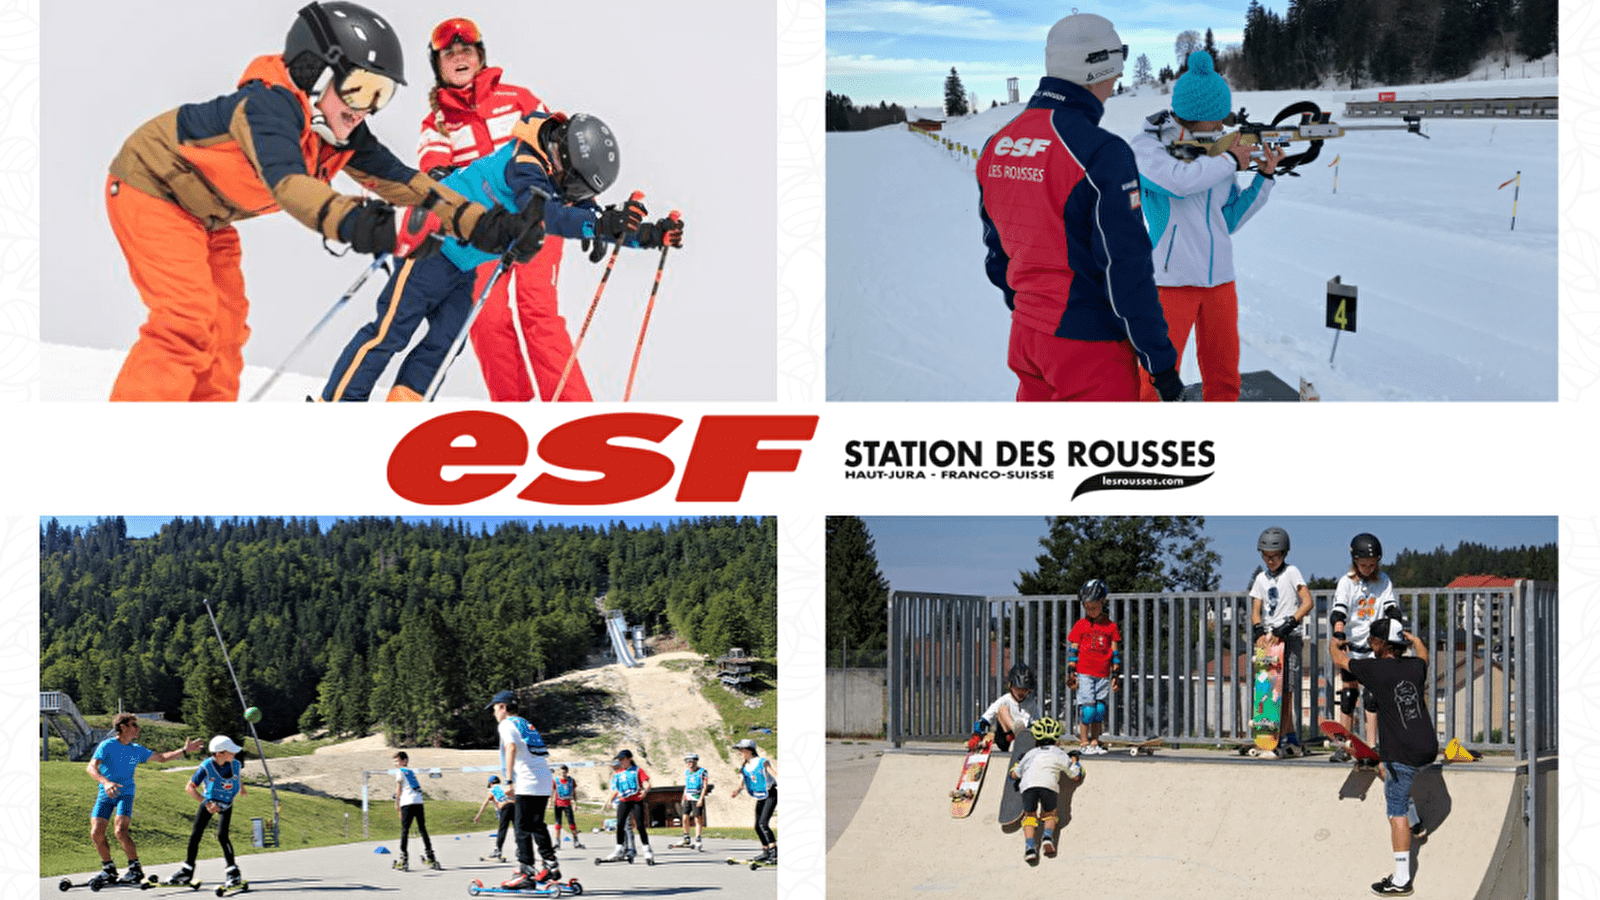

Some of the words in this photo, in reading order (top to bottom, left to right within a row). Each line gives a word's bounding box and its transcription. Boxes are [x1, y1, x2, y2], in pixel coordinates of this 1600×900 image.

[988, 164, 1003, 178] LES
[1004, 165, 1045, 182] ROUSSES
[1334, 298, 1348, 330] 4
